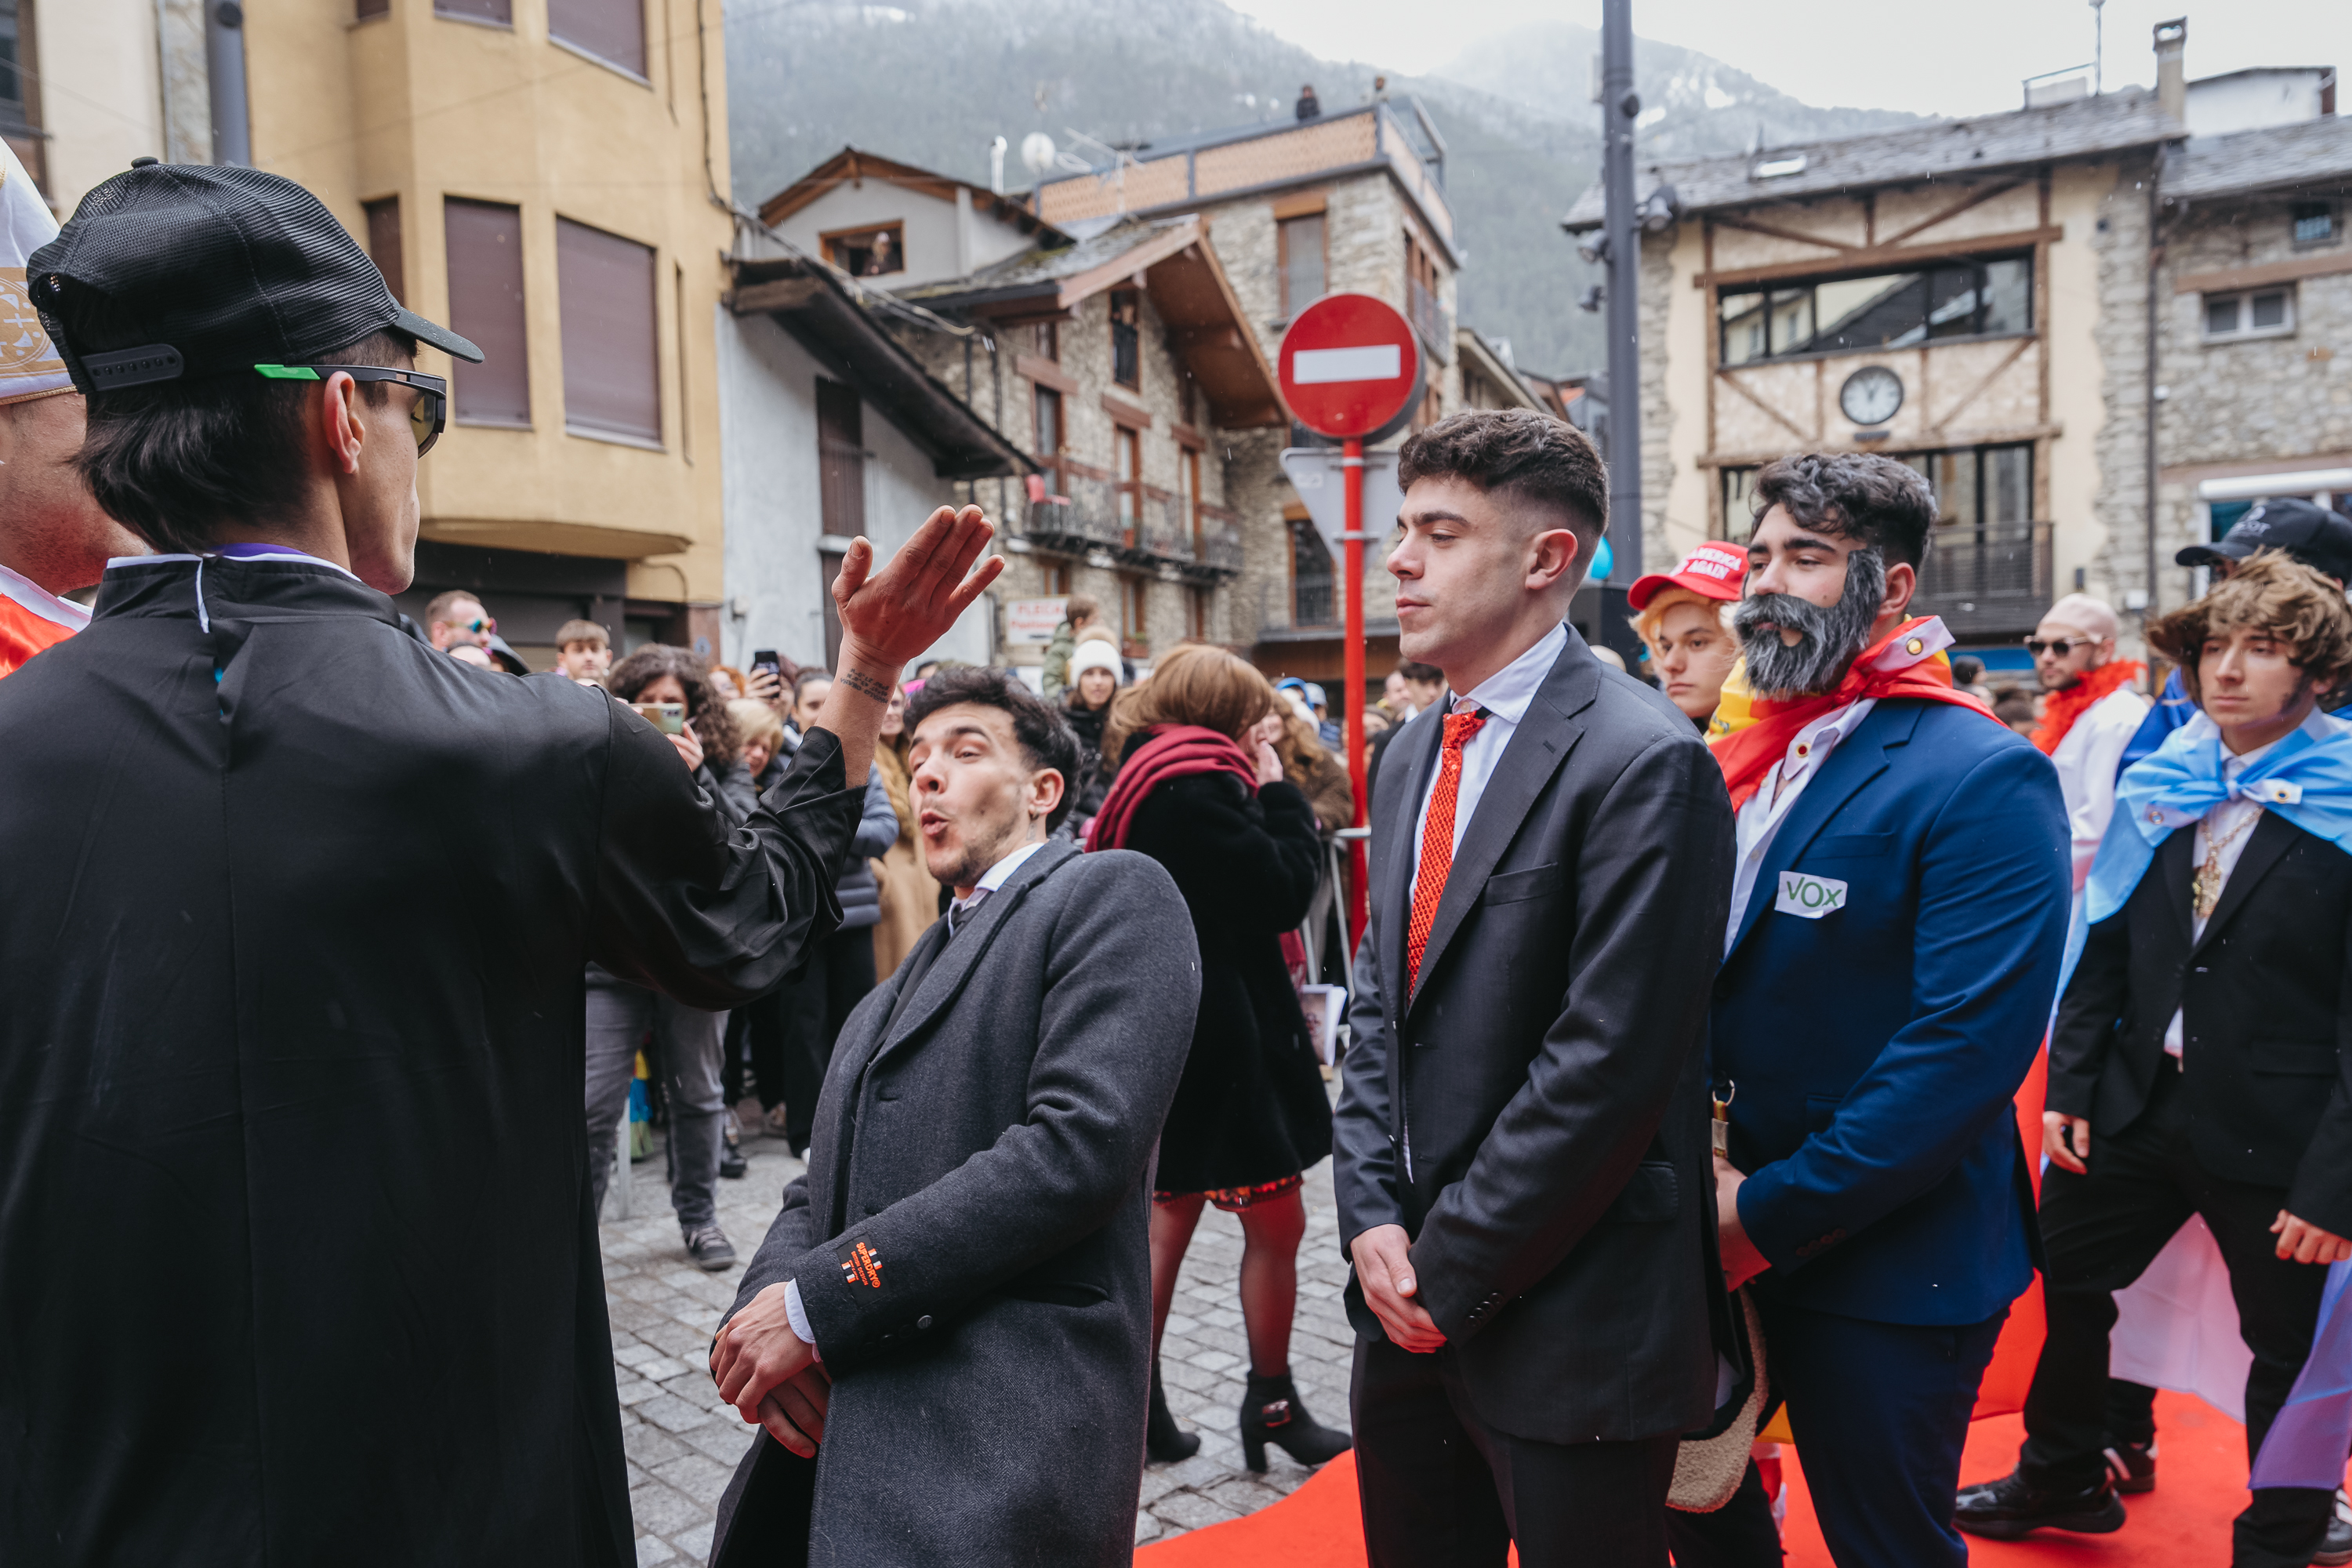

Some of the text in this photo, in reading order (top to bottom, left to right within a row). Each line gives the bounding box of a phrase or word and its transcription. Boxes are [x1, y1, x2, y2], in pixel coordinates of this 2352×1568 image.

[1686, 547, 1742, 571] AMERICA
[1687, 560, 1730, 580] AGAIN
[1787, 877, 1842, 907] VOX
[858, 1266, 869, 1286] DESIGN
